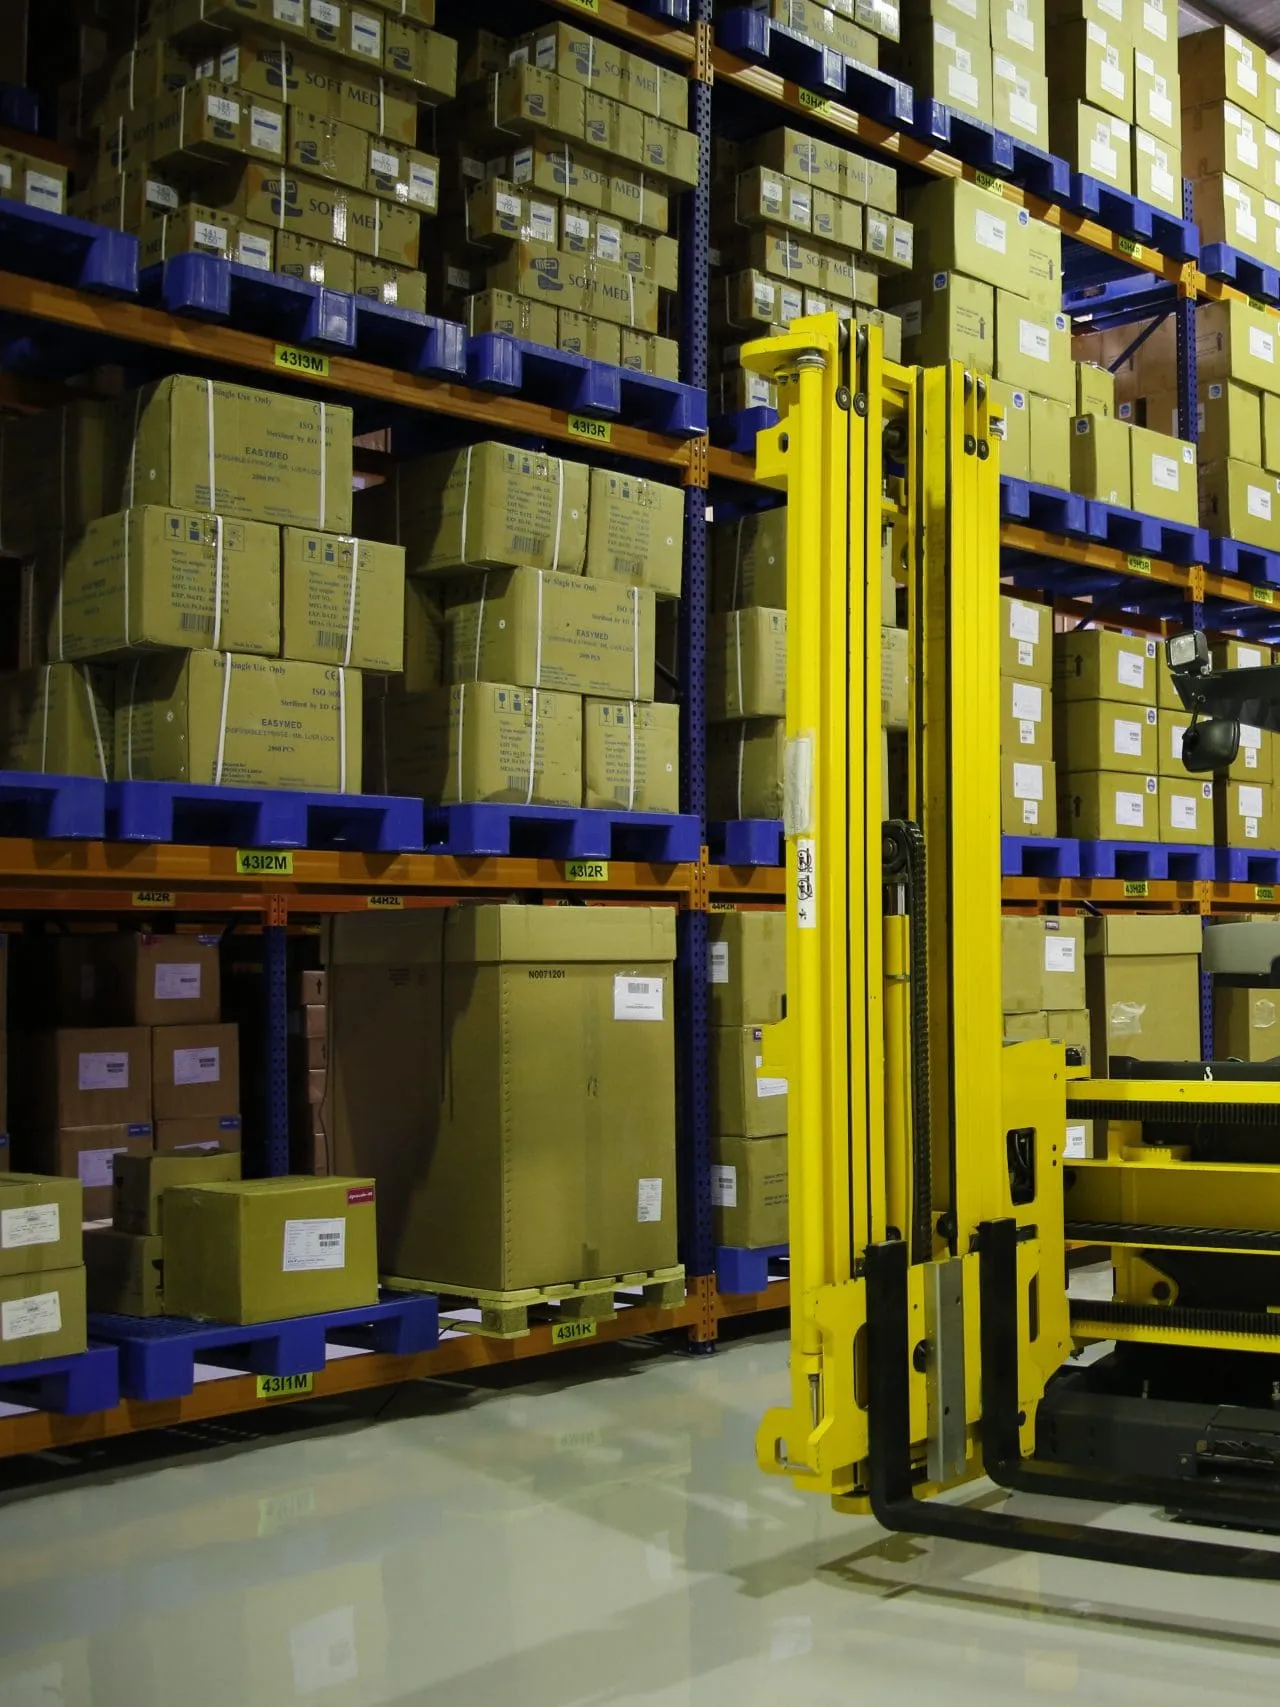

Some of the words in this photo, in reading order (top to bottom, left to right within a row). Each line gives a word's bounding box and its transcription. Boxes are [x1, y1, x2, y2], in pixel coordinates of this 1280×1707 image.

[305, 72, 342, 94] SOFT
[582, 169, 610, 189] SOFT
[615, 182, 641, 200] MED
[807, 255, 829, 270] SOFT
[569, 274, 598, 293] SOFT
[602, 285, 631, 302] MED
[280, 350, 323, 372] 43I3M
[573, 420, 606, 439] 43I3R
[245, 446, 288, 461] EASYMED
[576, 629, 609, 641] EASYMED
[312, 688, 326, 698] ISO
[262, 719, 303, 730] EASYMED
[242, 855, 286, 872] 43I2M
[570, 864, 603, 880] 43I2R
[557, 1322, 592, 1341] 43I1R
[262, 1375, 308, 1394] 43I1M
